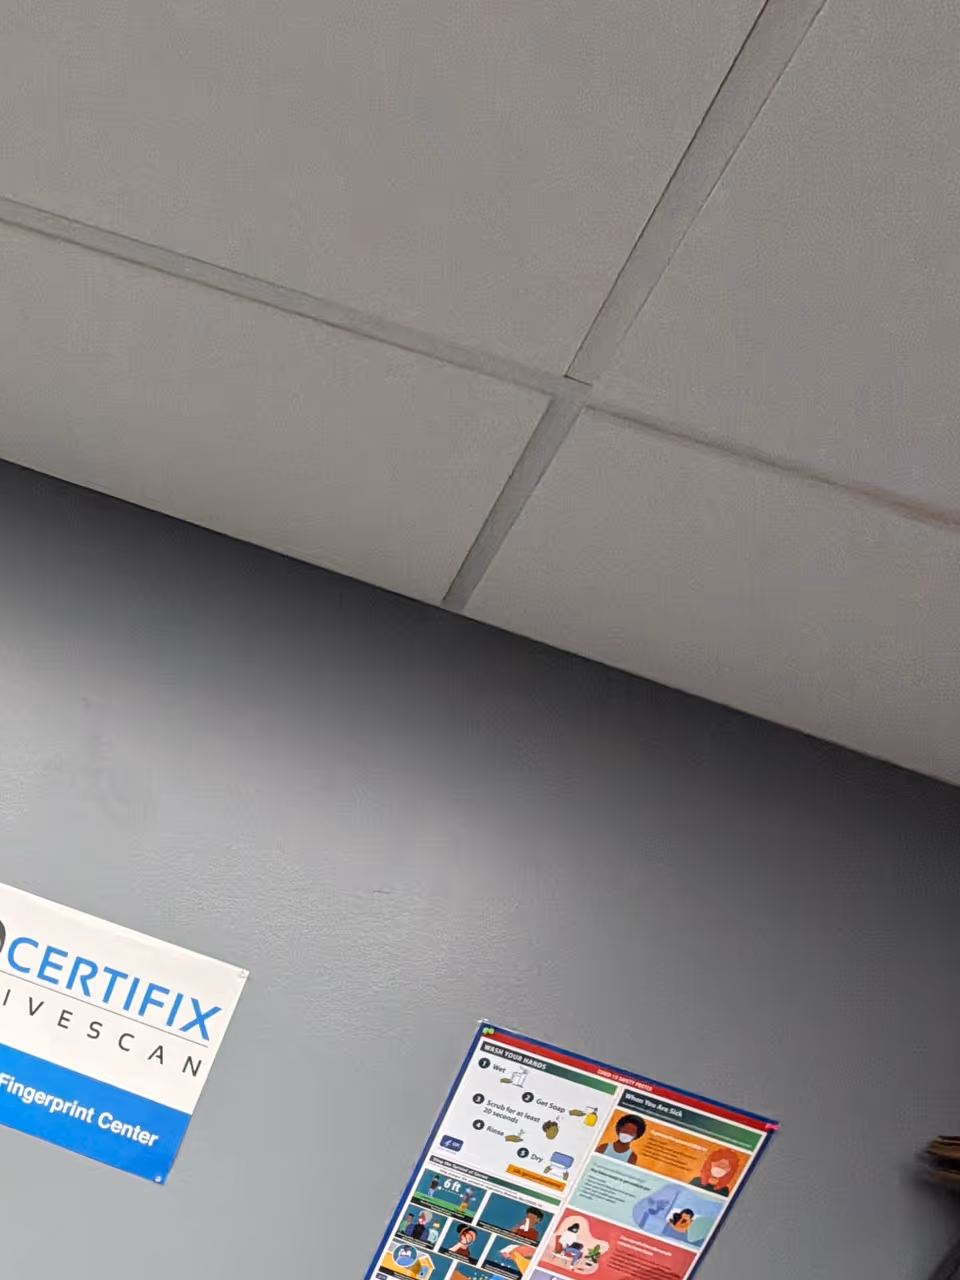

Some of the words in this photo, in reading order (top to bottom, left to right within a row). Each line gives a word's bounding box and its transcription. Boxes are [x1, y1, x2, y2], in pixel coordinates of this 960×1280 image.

[7, 935, 222, 1042] CERTIFIX
[483, 1044, 503, 1055] WASH
[504, 1051, 522, 1062] YOUR
[522, 1057, 546, 1070] HANDS
[493, 1064, 506, 1073] Wet
[487, 1100, 505, 1111] Scrub
[505, 1107, 516, 1115] for
[524, 1112, 540, 1123] least
[536, 1098, 548, 1107] Get
[549, 1102, 565, 1114] Soap
[624, 1091, 644, 1104] When
[643, 1099, 657, 1109] You
[656, 1103, 669, 1113] Are
[668, 1107, 683, 1118] Sick
[492, 1111, 518, 1124] seconds
[98, 1111, 159, 1148] Center
[486, 1126, 504, 1136] Rinse
[530, 1154, 543, 1163] Dry
[443, 1179, 452, 1188] 6
[452, 1180, 461, 1191] ft
